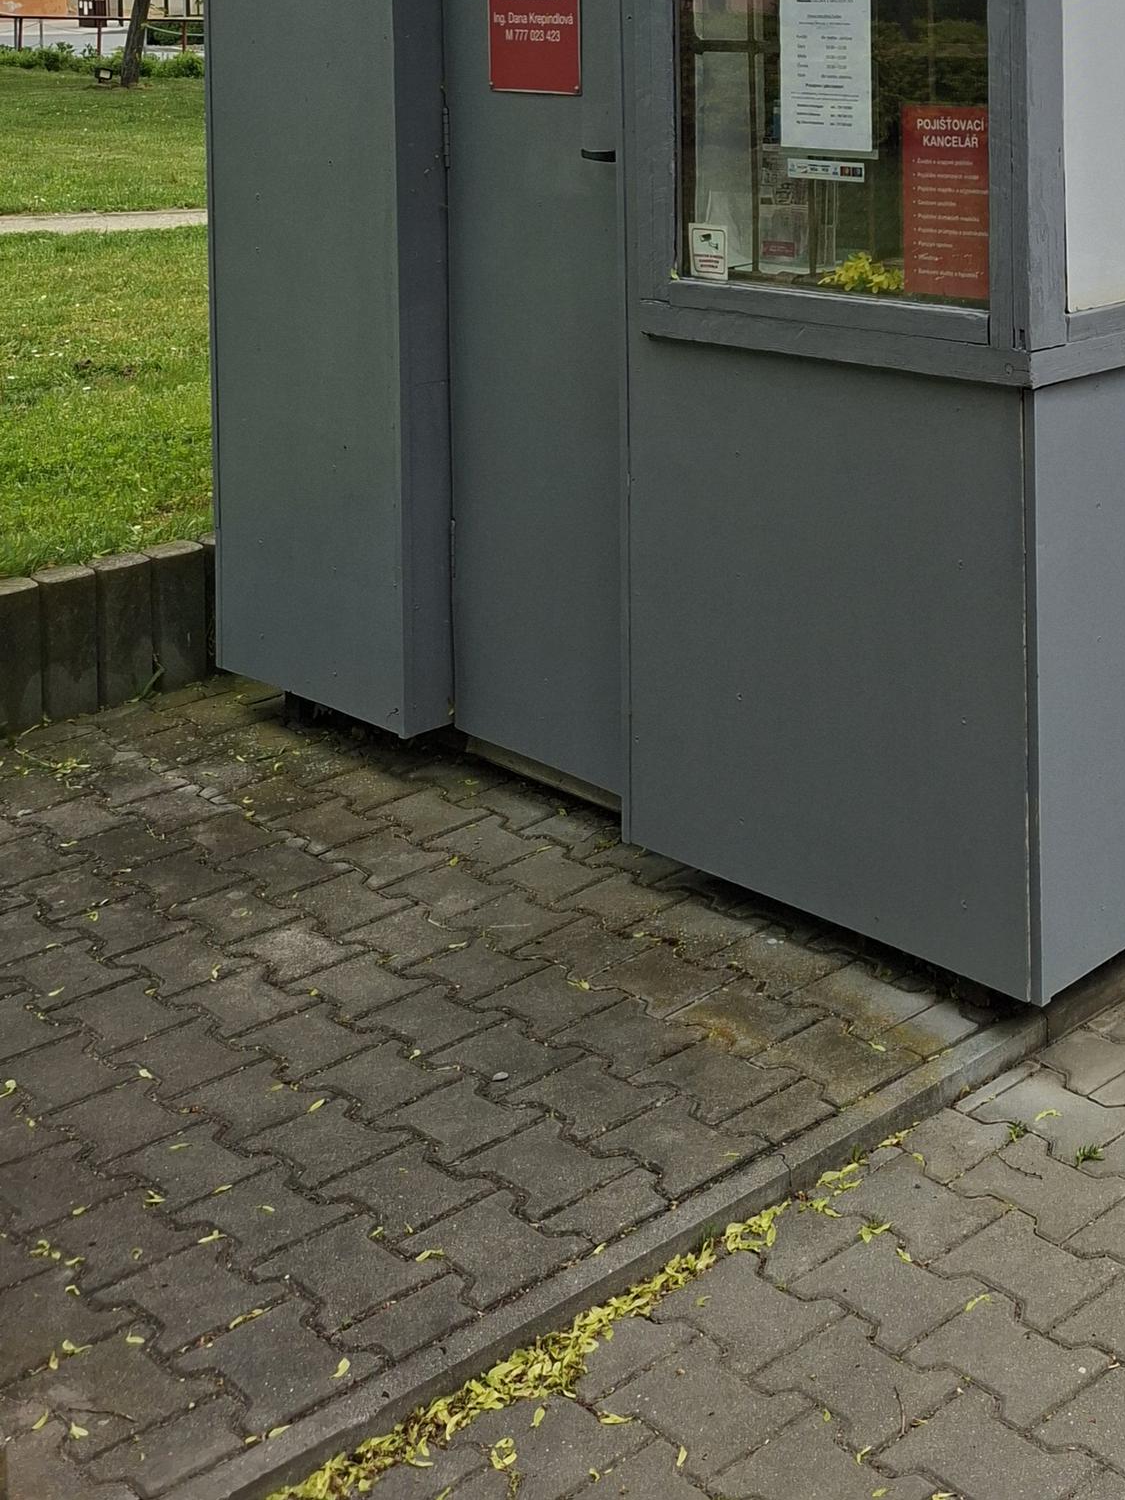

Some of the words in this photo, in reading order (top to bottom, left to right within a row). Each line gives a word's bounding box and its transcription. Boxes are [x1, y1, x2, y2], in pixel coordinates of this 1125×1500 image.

[508, 12, 528, 24] Dana
[505, 29, 513, 41] M
[515, 29, 529, 41] 777
[916, 116, 985, 131] POJIŠŤOVACÍ
[922, 134, 979, 148] KANCELÁŘ
